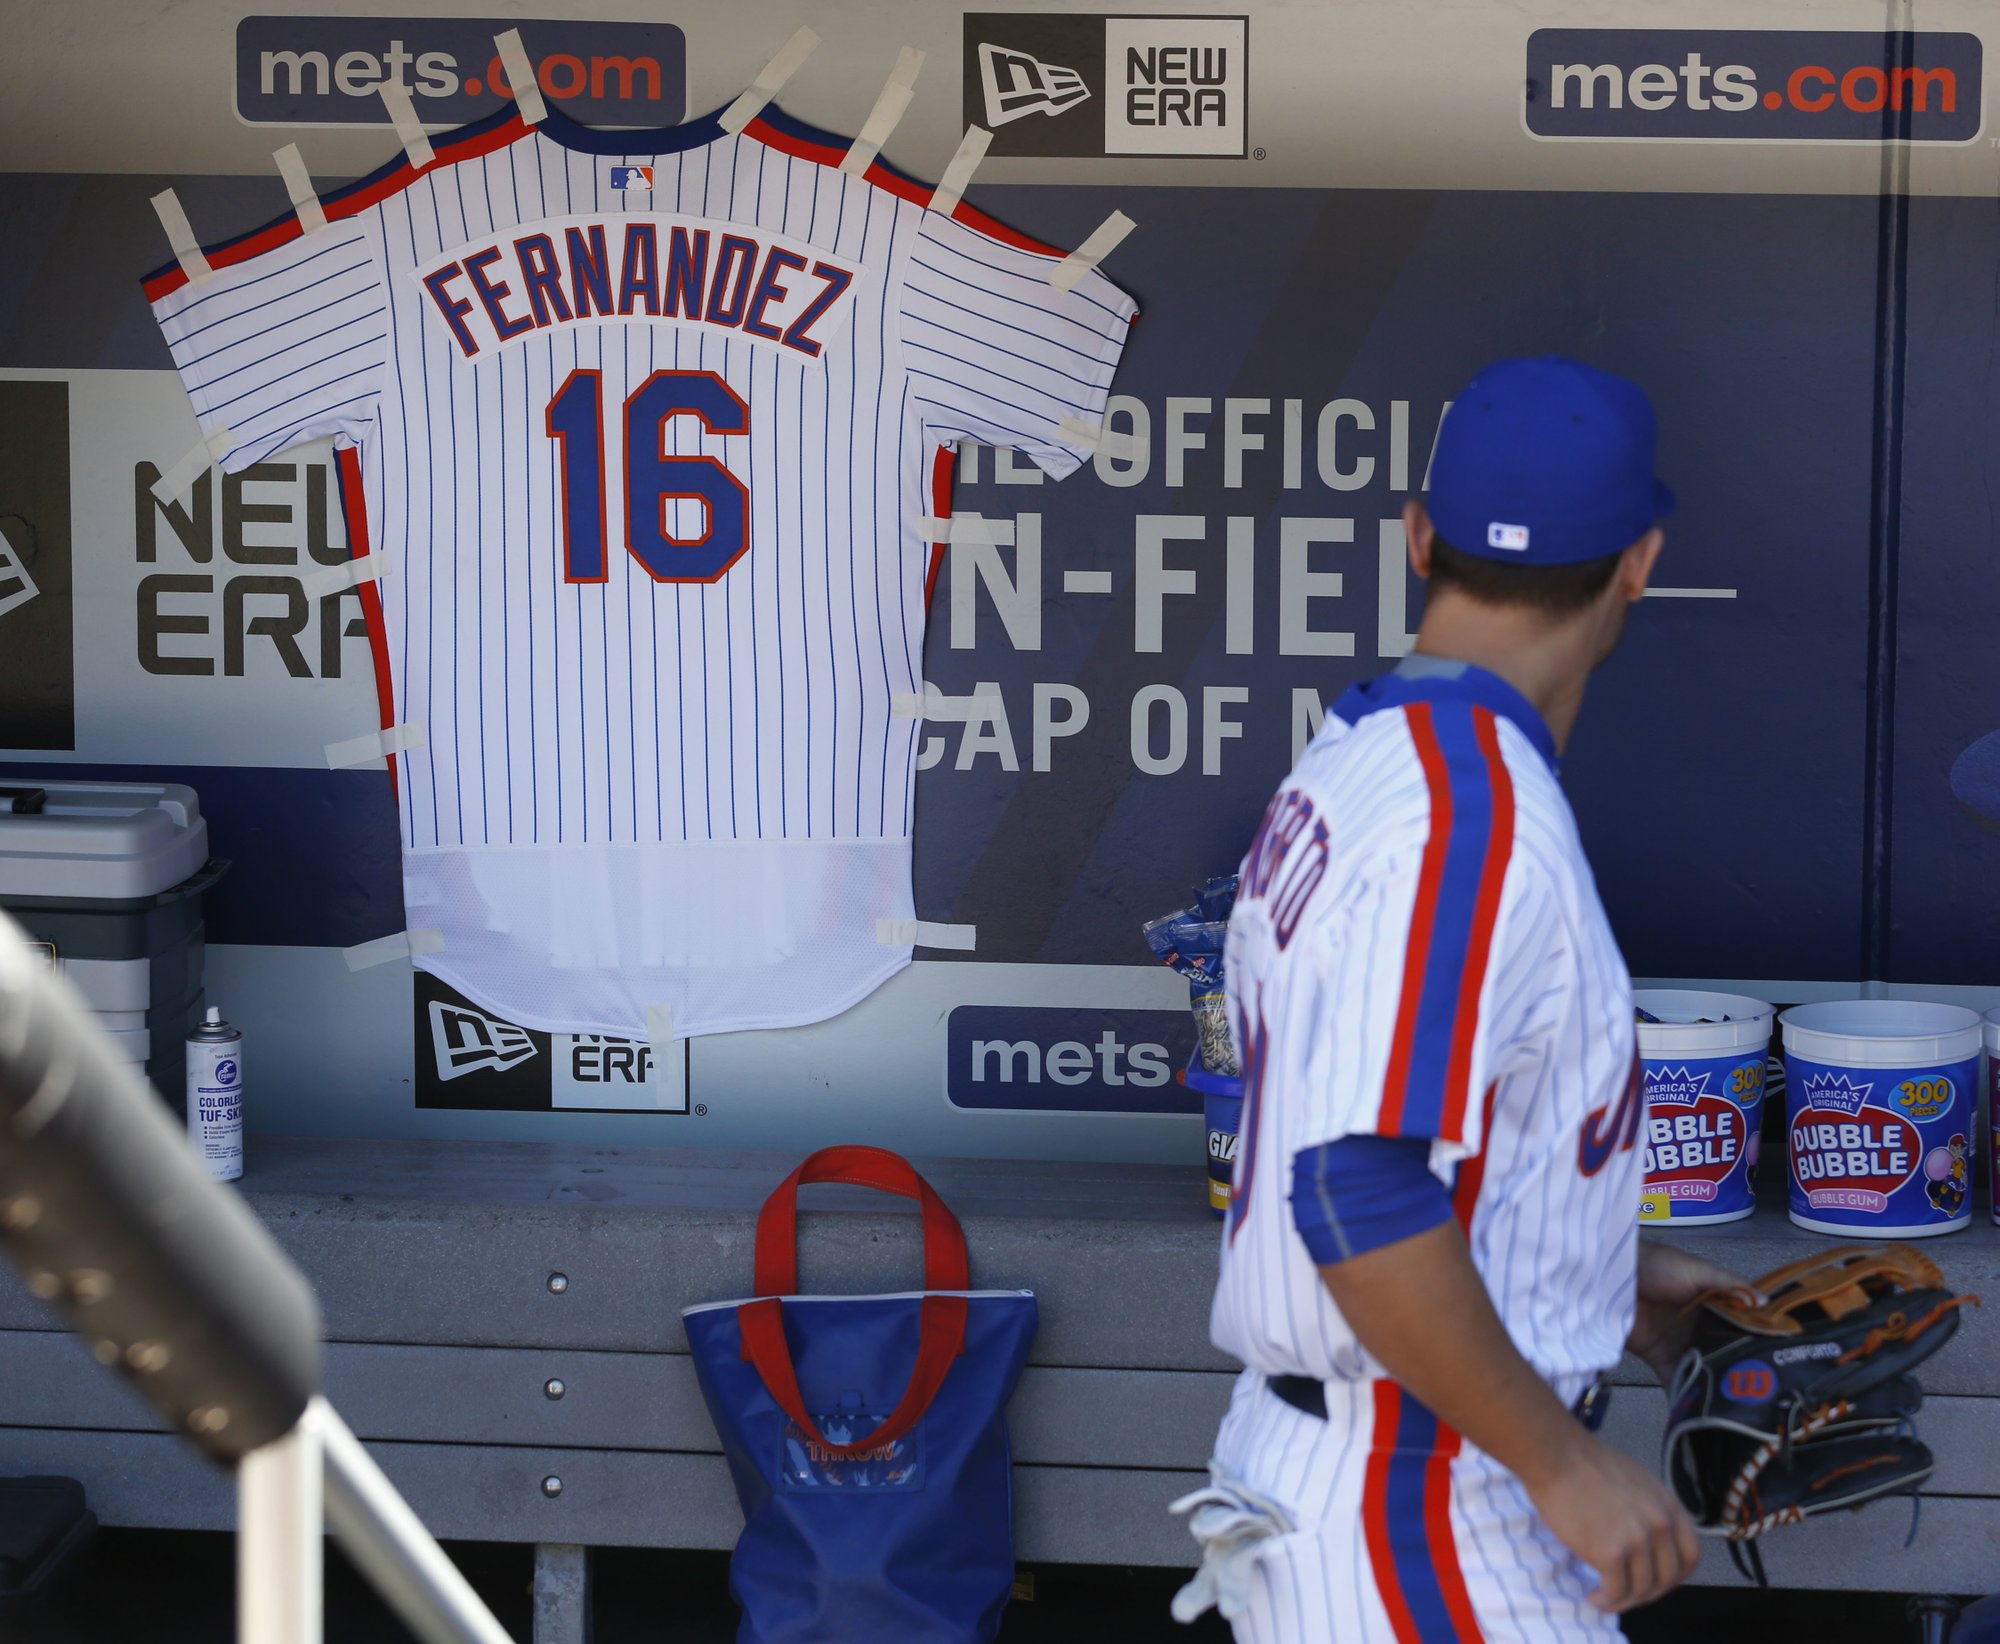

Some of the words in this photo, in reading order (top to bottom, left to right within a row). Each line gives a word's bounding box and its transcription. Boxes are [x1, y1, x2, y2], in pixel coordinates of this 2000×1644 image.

[1127, 47, 1227, 86] NEW
[1551, 52, 1957, 113] mets.com
[1127, 88, 1226, 127] ERA
[423, 223, 854, 357] FERNANDEZ
[1093, 395, 1454, 492] OFFICI
[545, 369, 750, 584] 16
[950, 511, 1419, 658] N-FIEL
[1130, 684, 1249, 776] OF
[199, 1094, 242, 1108] COLORLES
[1811, 1089, 1860, 1102] AMERICA'S
[1814, 1099, 1854, 1111] ORIGINAL
[1899, 1078, 1949, 1107] 300
[199, 1107, 242, 1122] TUF-SKI
[1648, 1112, 1733, 1144] BBLE
[1793, 1124, 1902, 1152] DUBBLE
[1643, 1138, 1737, 1174] UBBLE
[1797, 1152, 1909, 1181] BUBBLE
[1681, 1185, 1711, 1196] GUM
[1812, 1193, 1845, 1205] BUBBLE
[1848, 1194, 1879, 1207] GUM
